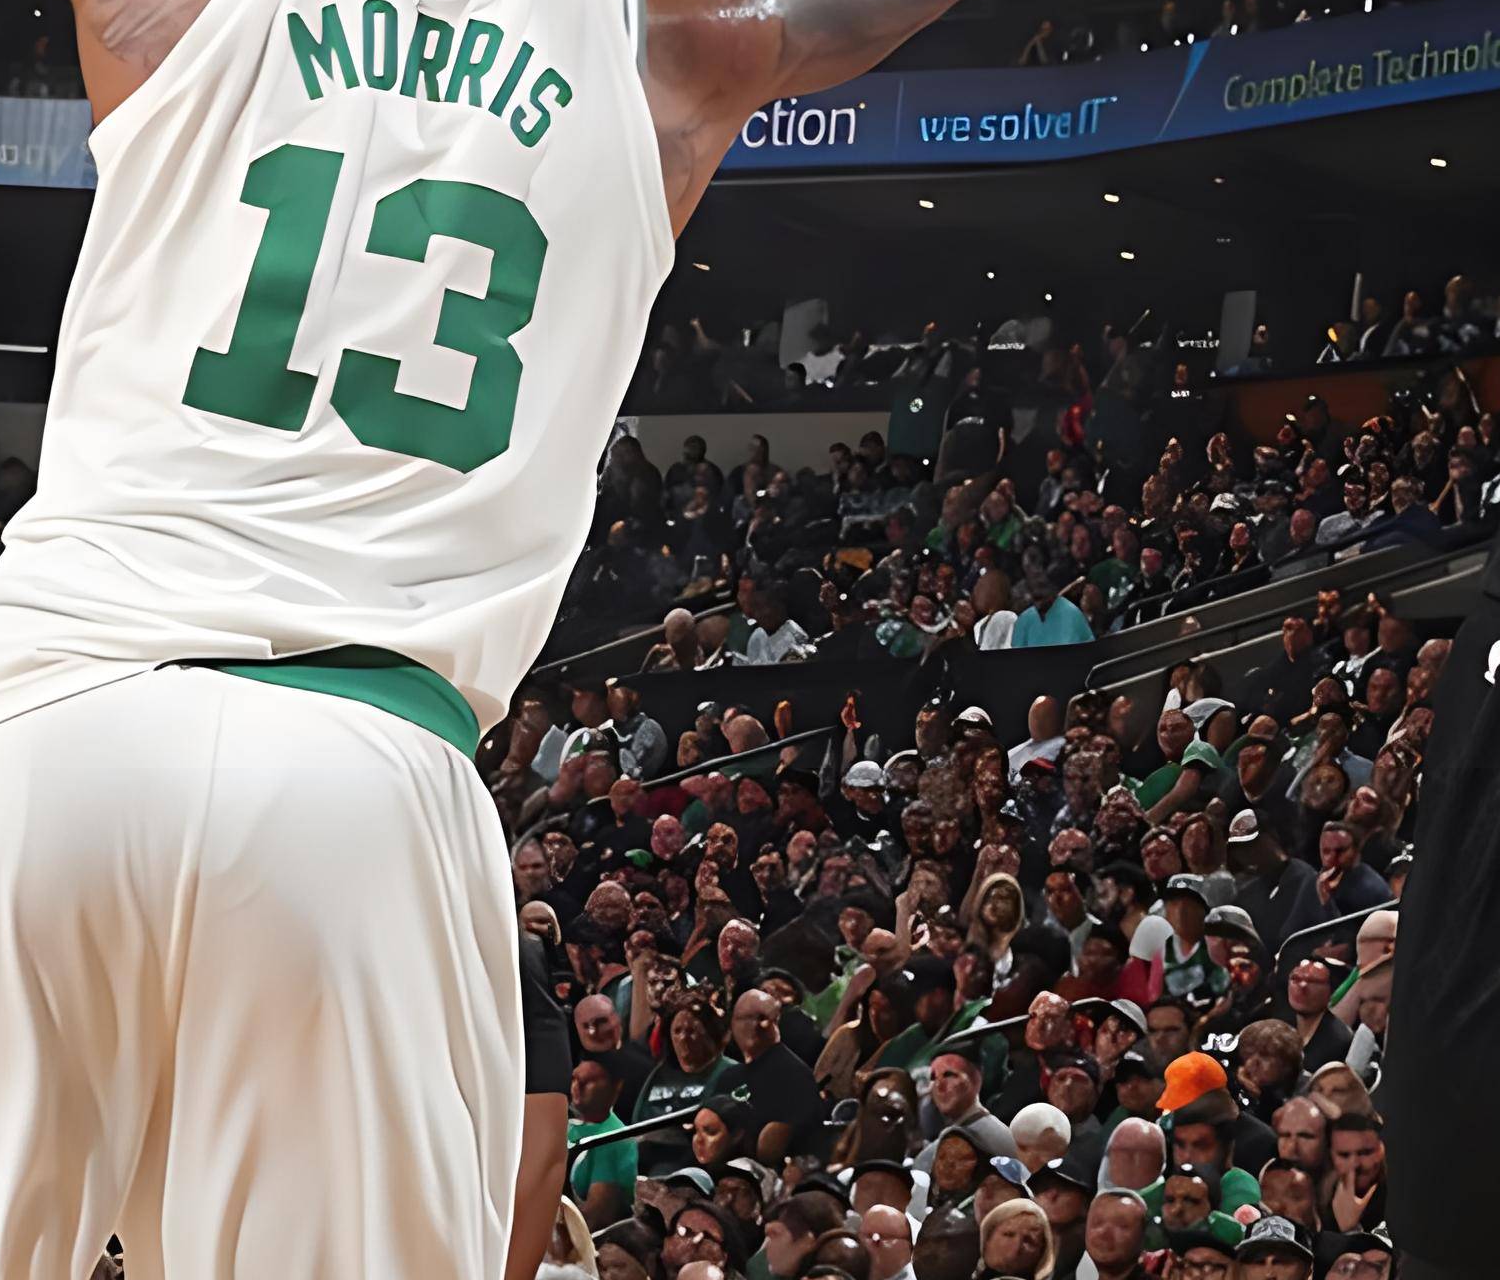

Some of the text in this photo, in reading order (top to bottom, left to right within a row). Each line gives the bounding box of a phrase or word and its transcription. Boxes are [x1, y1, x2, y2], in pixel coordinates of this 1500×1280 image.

[1223, 60, 1363, 112] Complete
[919, 115, 970, 142] we
[978, 103, 1071, 142] solve
[181, 143, 549, 474] 13
